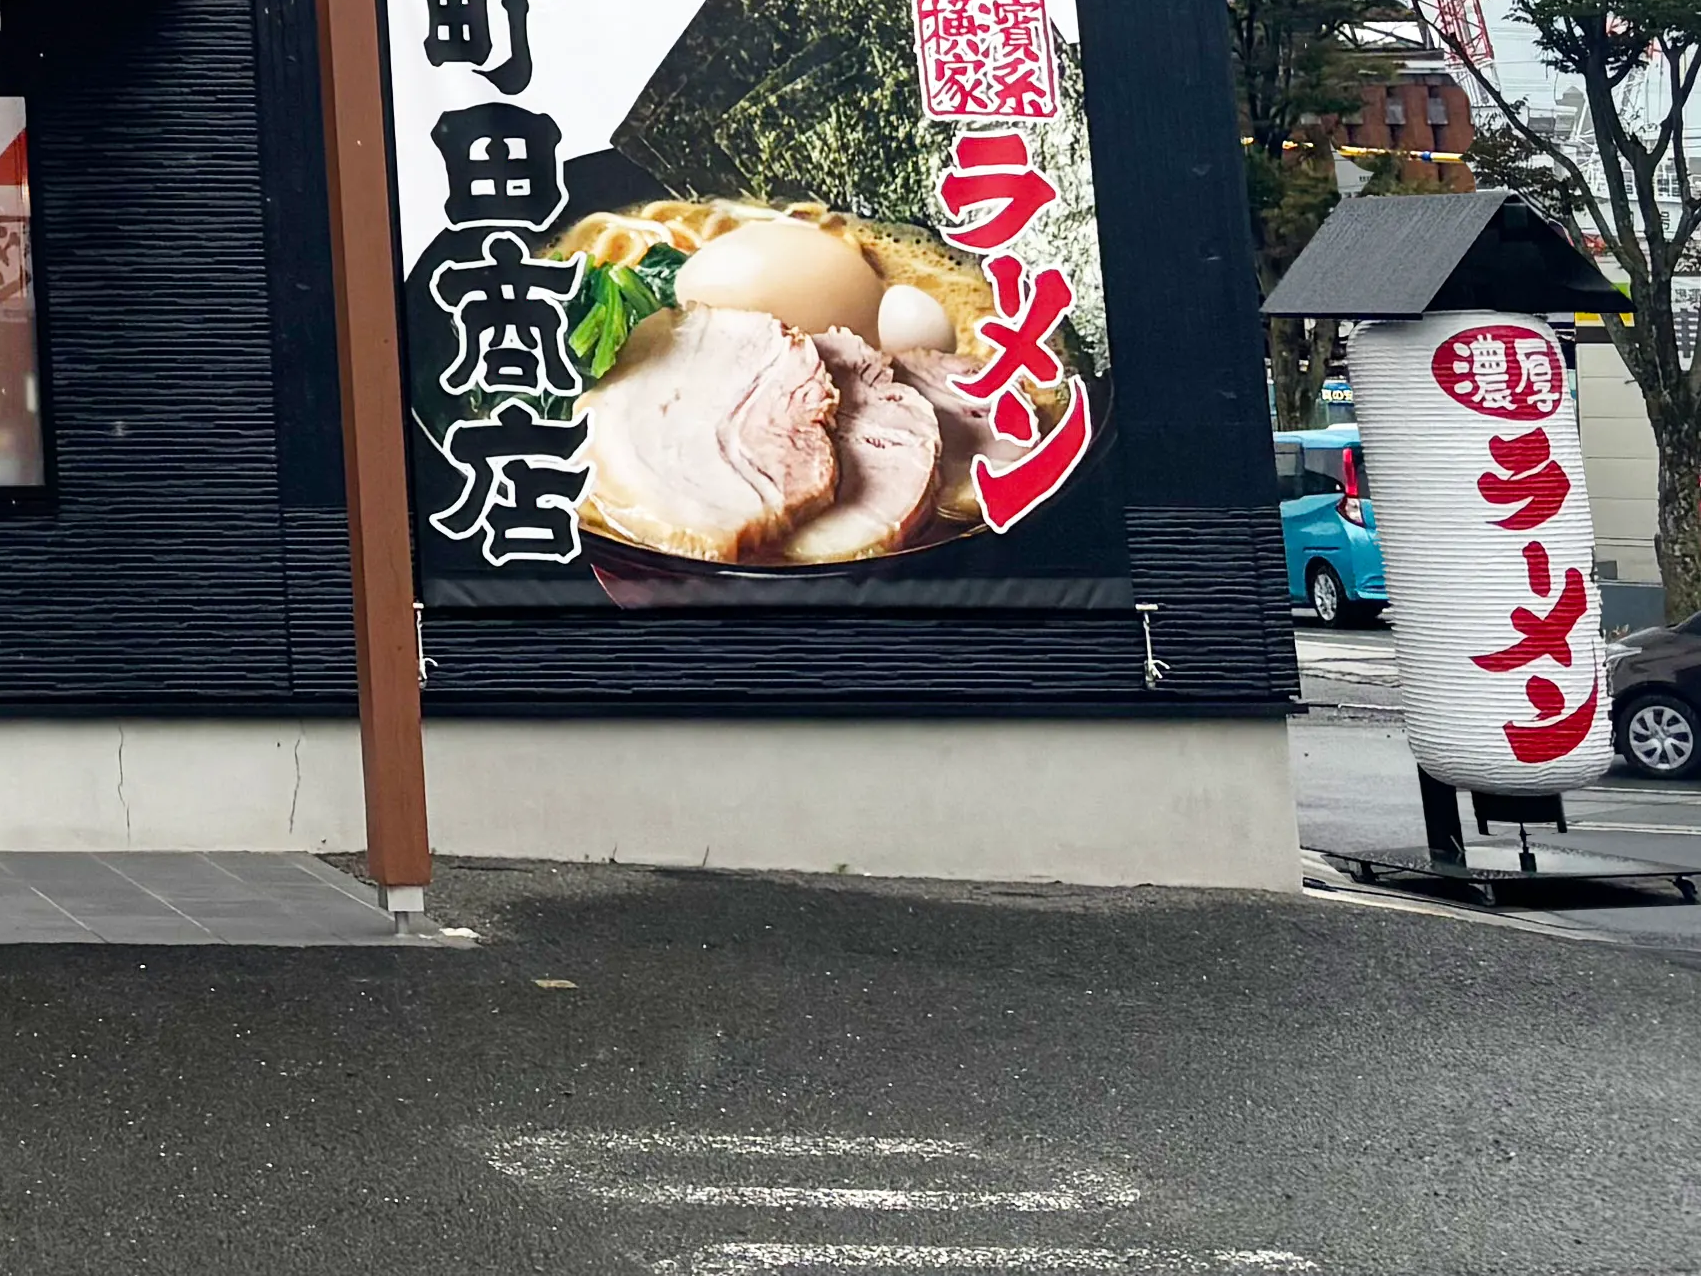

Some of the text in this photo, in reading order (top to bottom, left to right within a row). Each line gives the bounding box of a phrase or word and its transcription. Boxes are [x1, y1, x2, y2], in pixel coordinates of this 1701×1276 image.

[938, 132, 1092, 535] ラーメン
[1453, 335, 1562, 414] 濃厚
[1471, 427, 1600, 764] ラーメン
